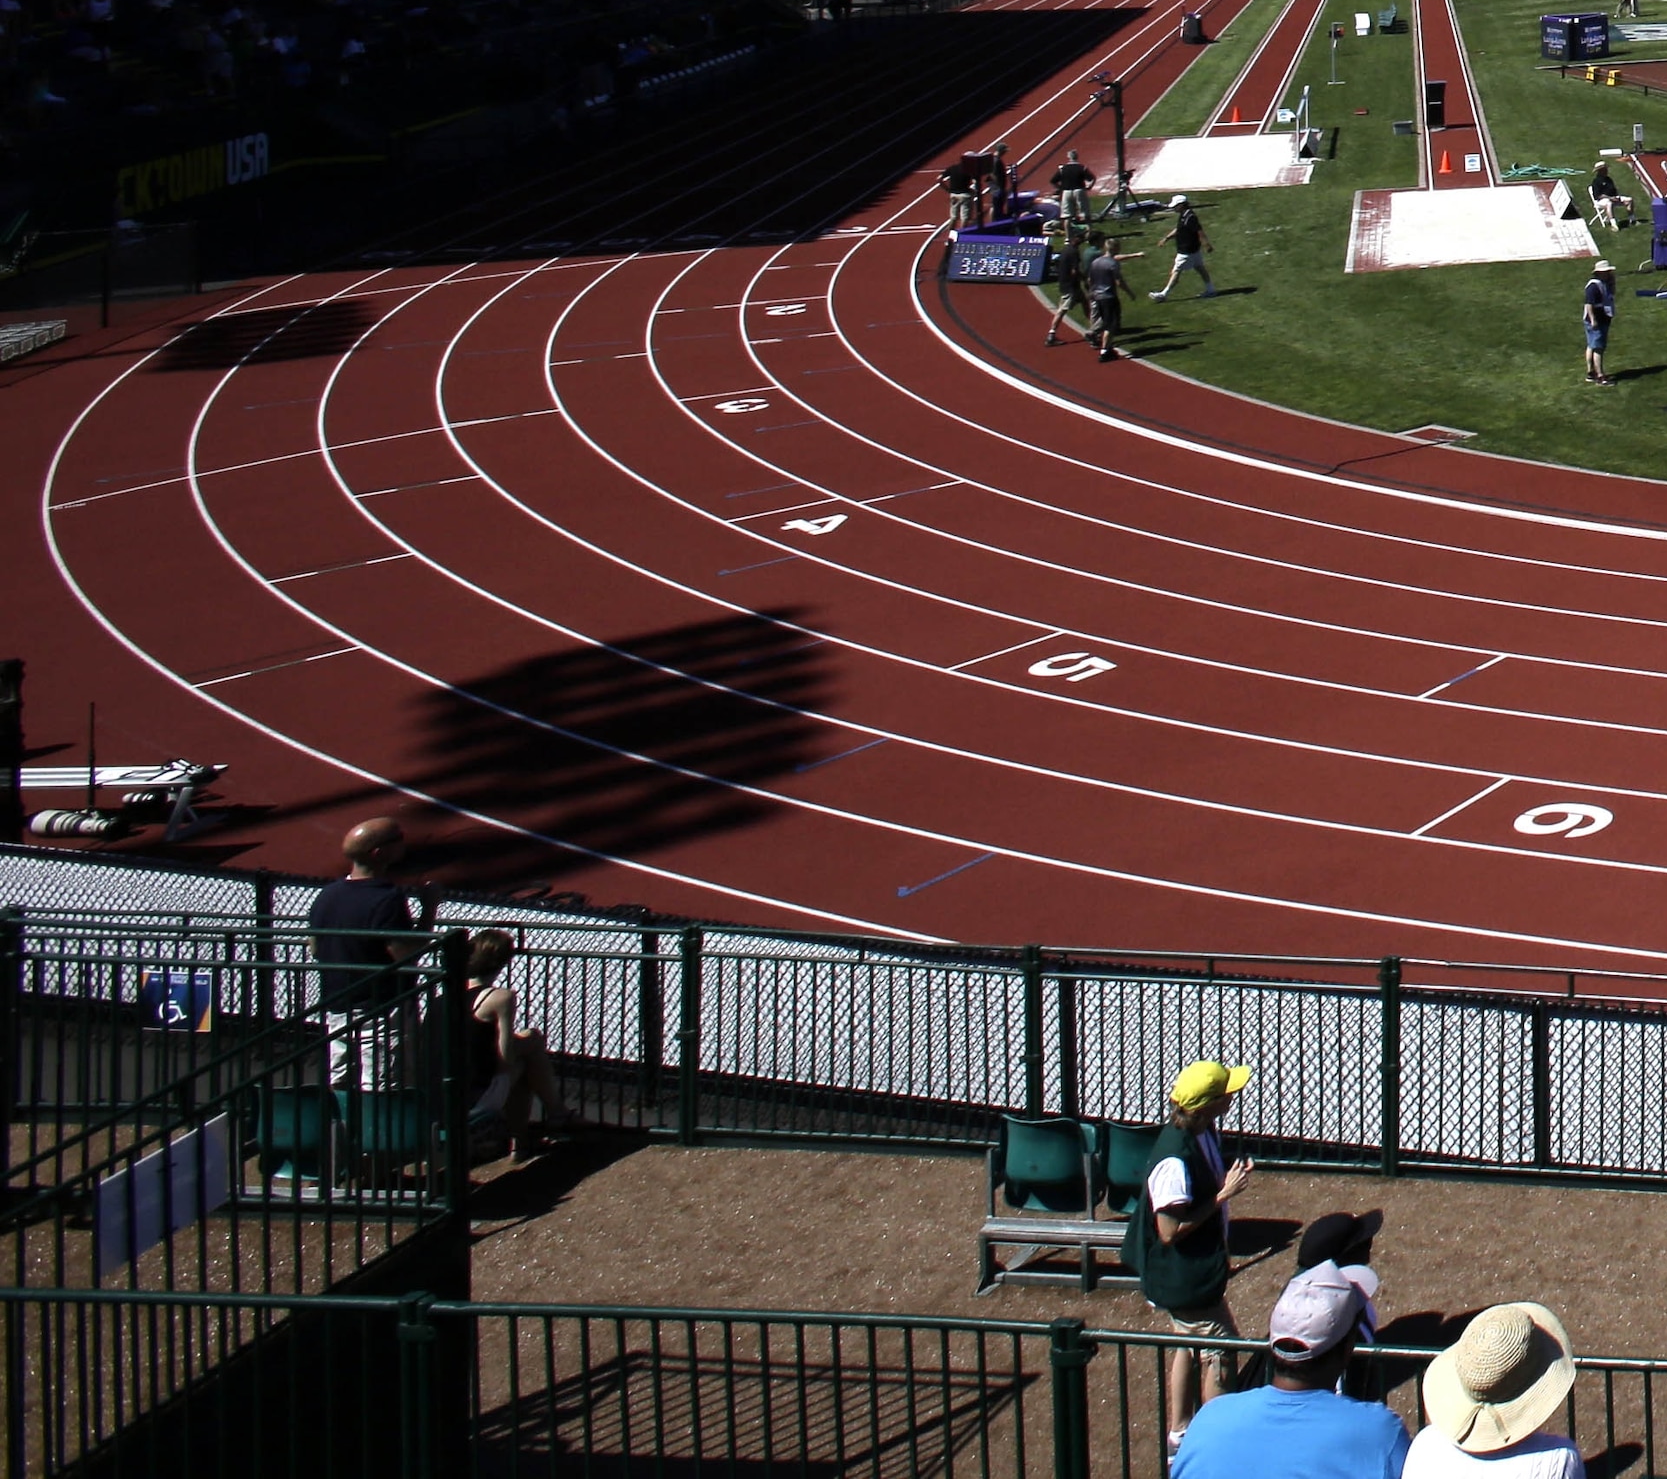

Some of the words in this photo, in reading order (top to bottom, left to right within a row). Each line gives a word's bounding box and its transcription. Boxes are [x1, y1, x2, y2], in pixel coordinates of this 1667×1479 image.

[225, 131, 271, 186] USA
[960, 257, 1031, 277] 3:28:50
[780, 514, 848, 535] 4
[1028, 652, 1117, 682] 5
[1514, 802, 1613, 839] 6
